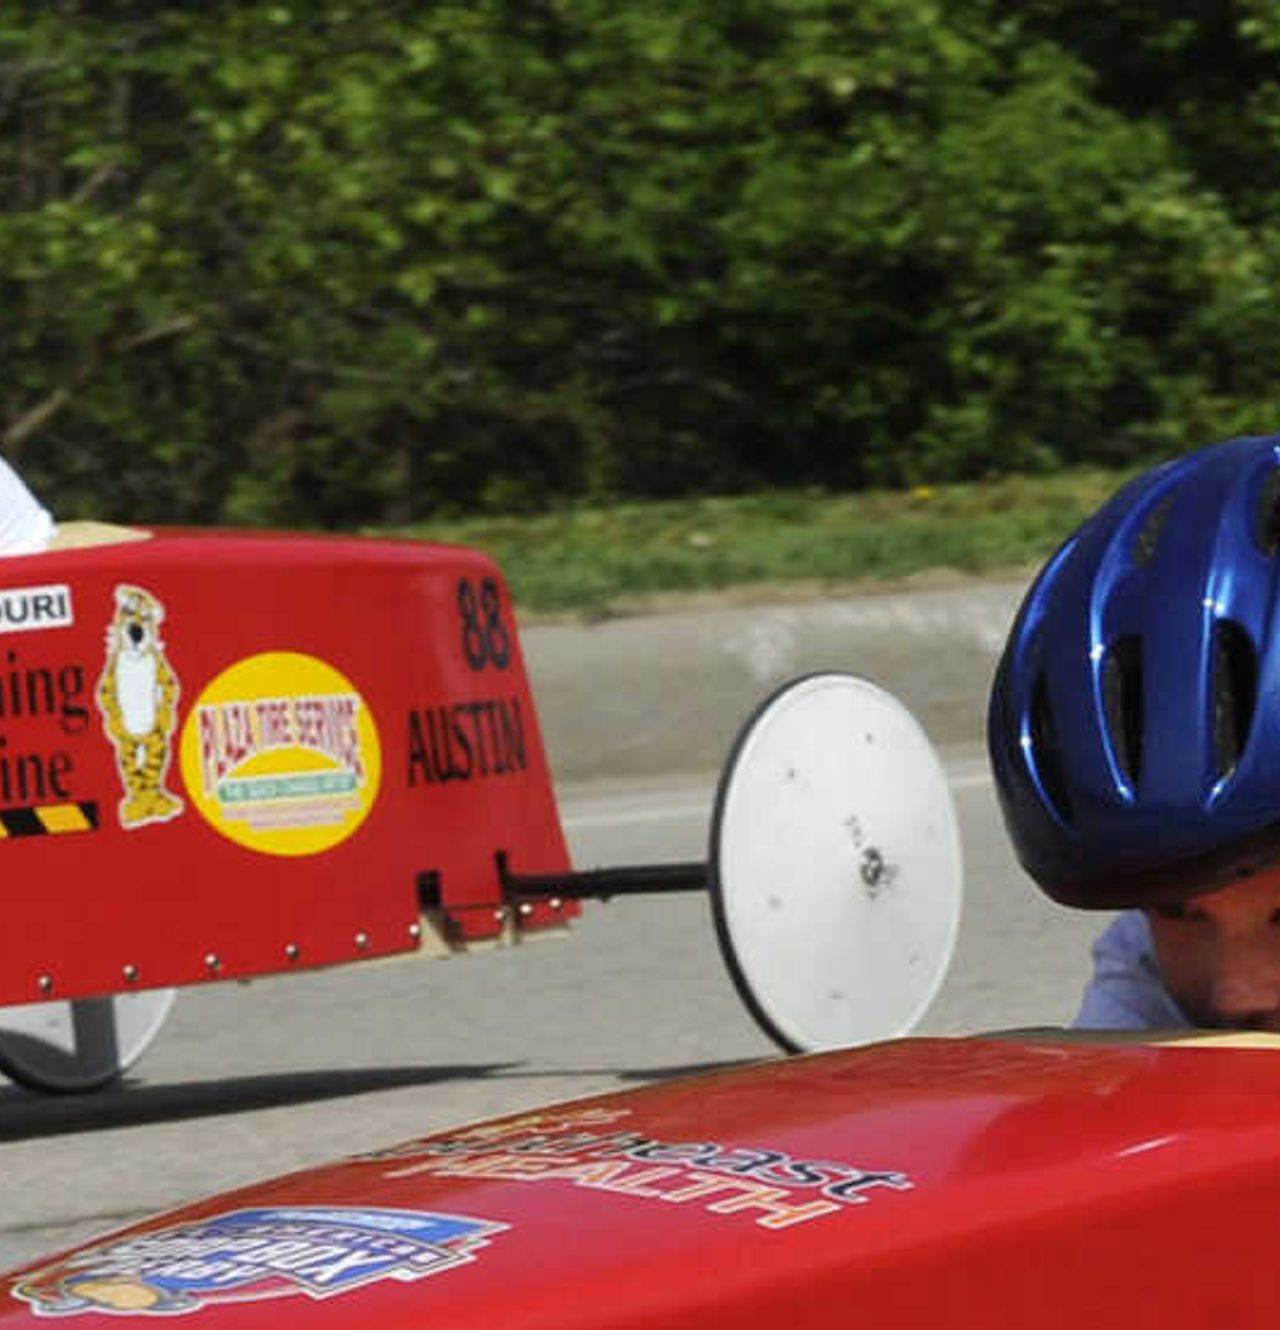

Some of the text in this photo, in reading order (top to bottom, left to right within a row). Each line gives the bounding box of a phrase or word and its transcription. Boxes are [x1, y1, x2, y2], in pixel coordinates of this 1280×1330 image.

[457, 576, 511, 671] 88
[407, 696, 527, 788] AUSTIN
[384, 1154, 843, 1230] HEALTH
